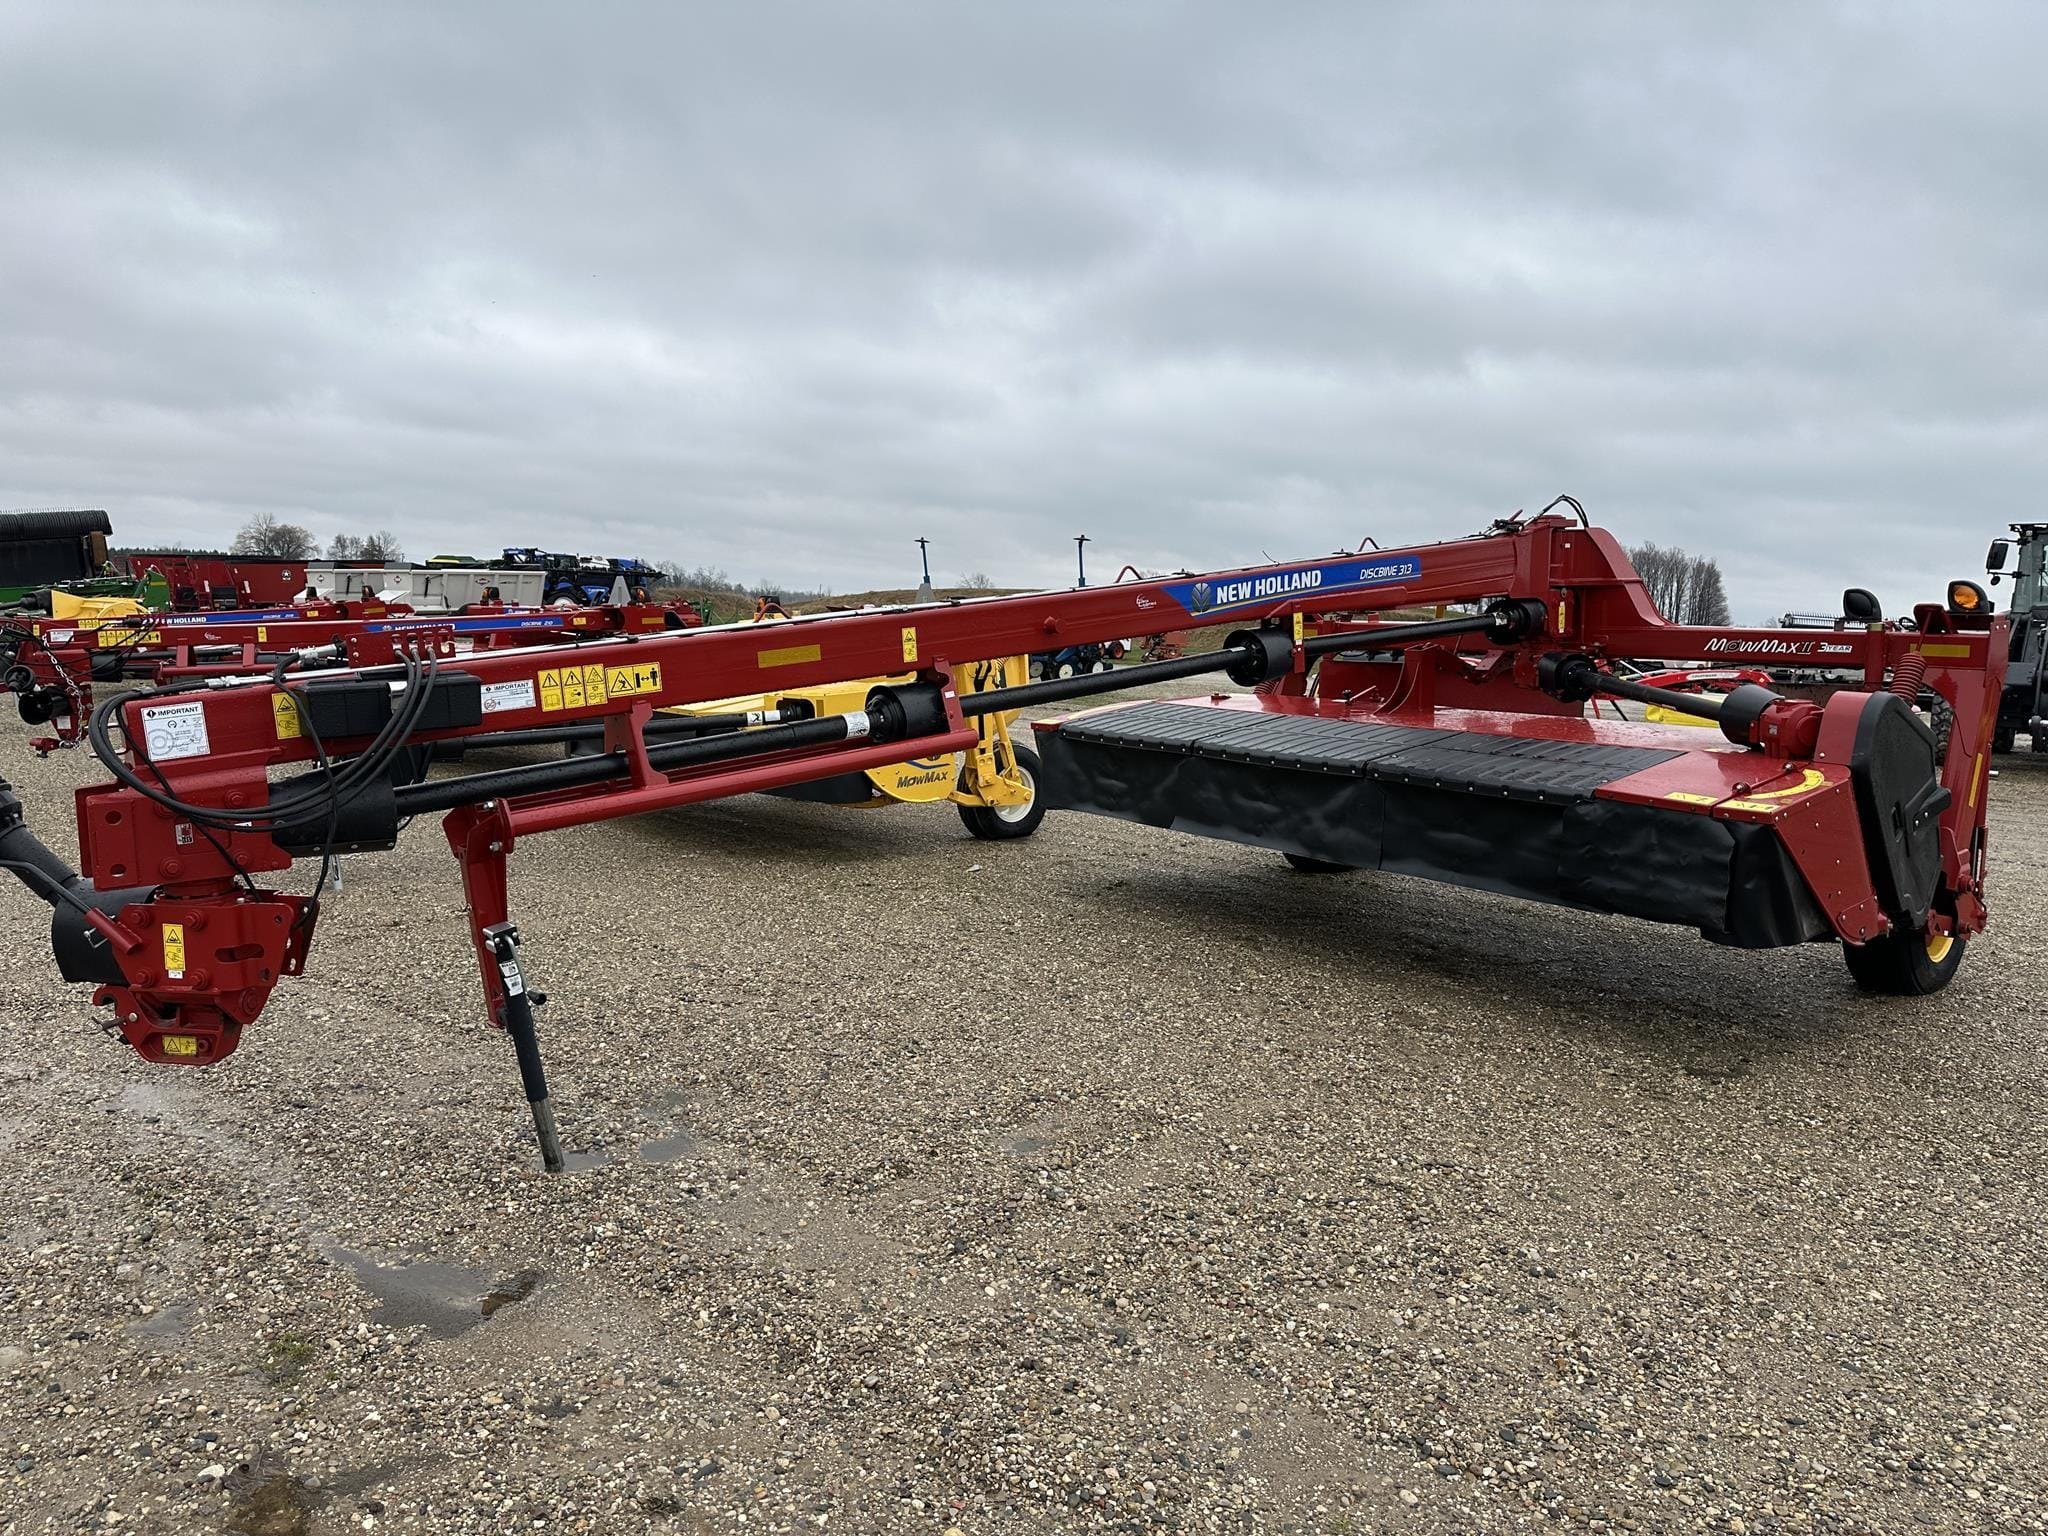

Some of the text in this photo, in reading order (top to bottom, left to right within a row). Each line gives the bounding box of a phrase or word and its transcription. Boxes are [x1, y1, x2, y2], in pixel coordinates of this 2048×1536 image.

[1360, 563, 1413, 580] DISCBINE 313
[1216, 570, 1322, 604] NEW HOLLAND
[174, 616, 207, 624] HOLLAND
[494, 682, 529, 691] IMPORTANT
[158, 706, 199, 717] IMPORTANT
